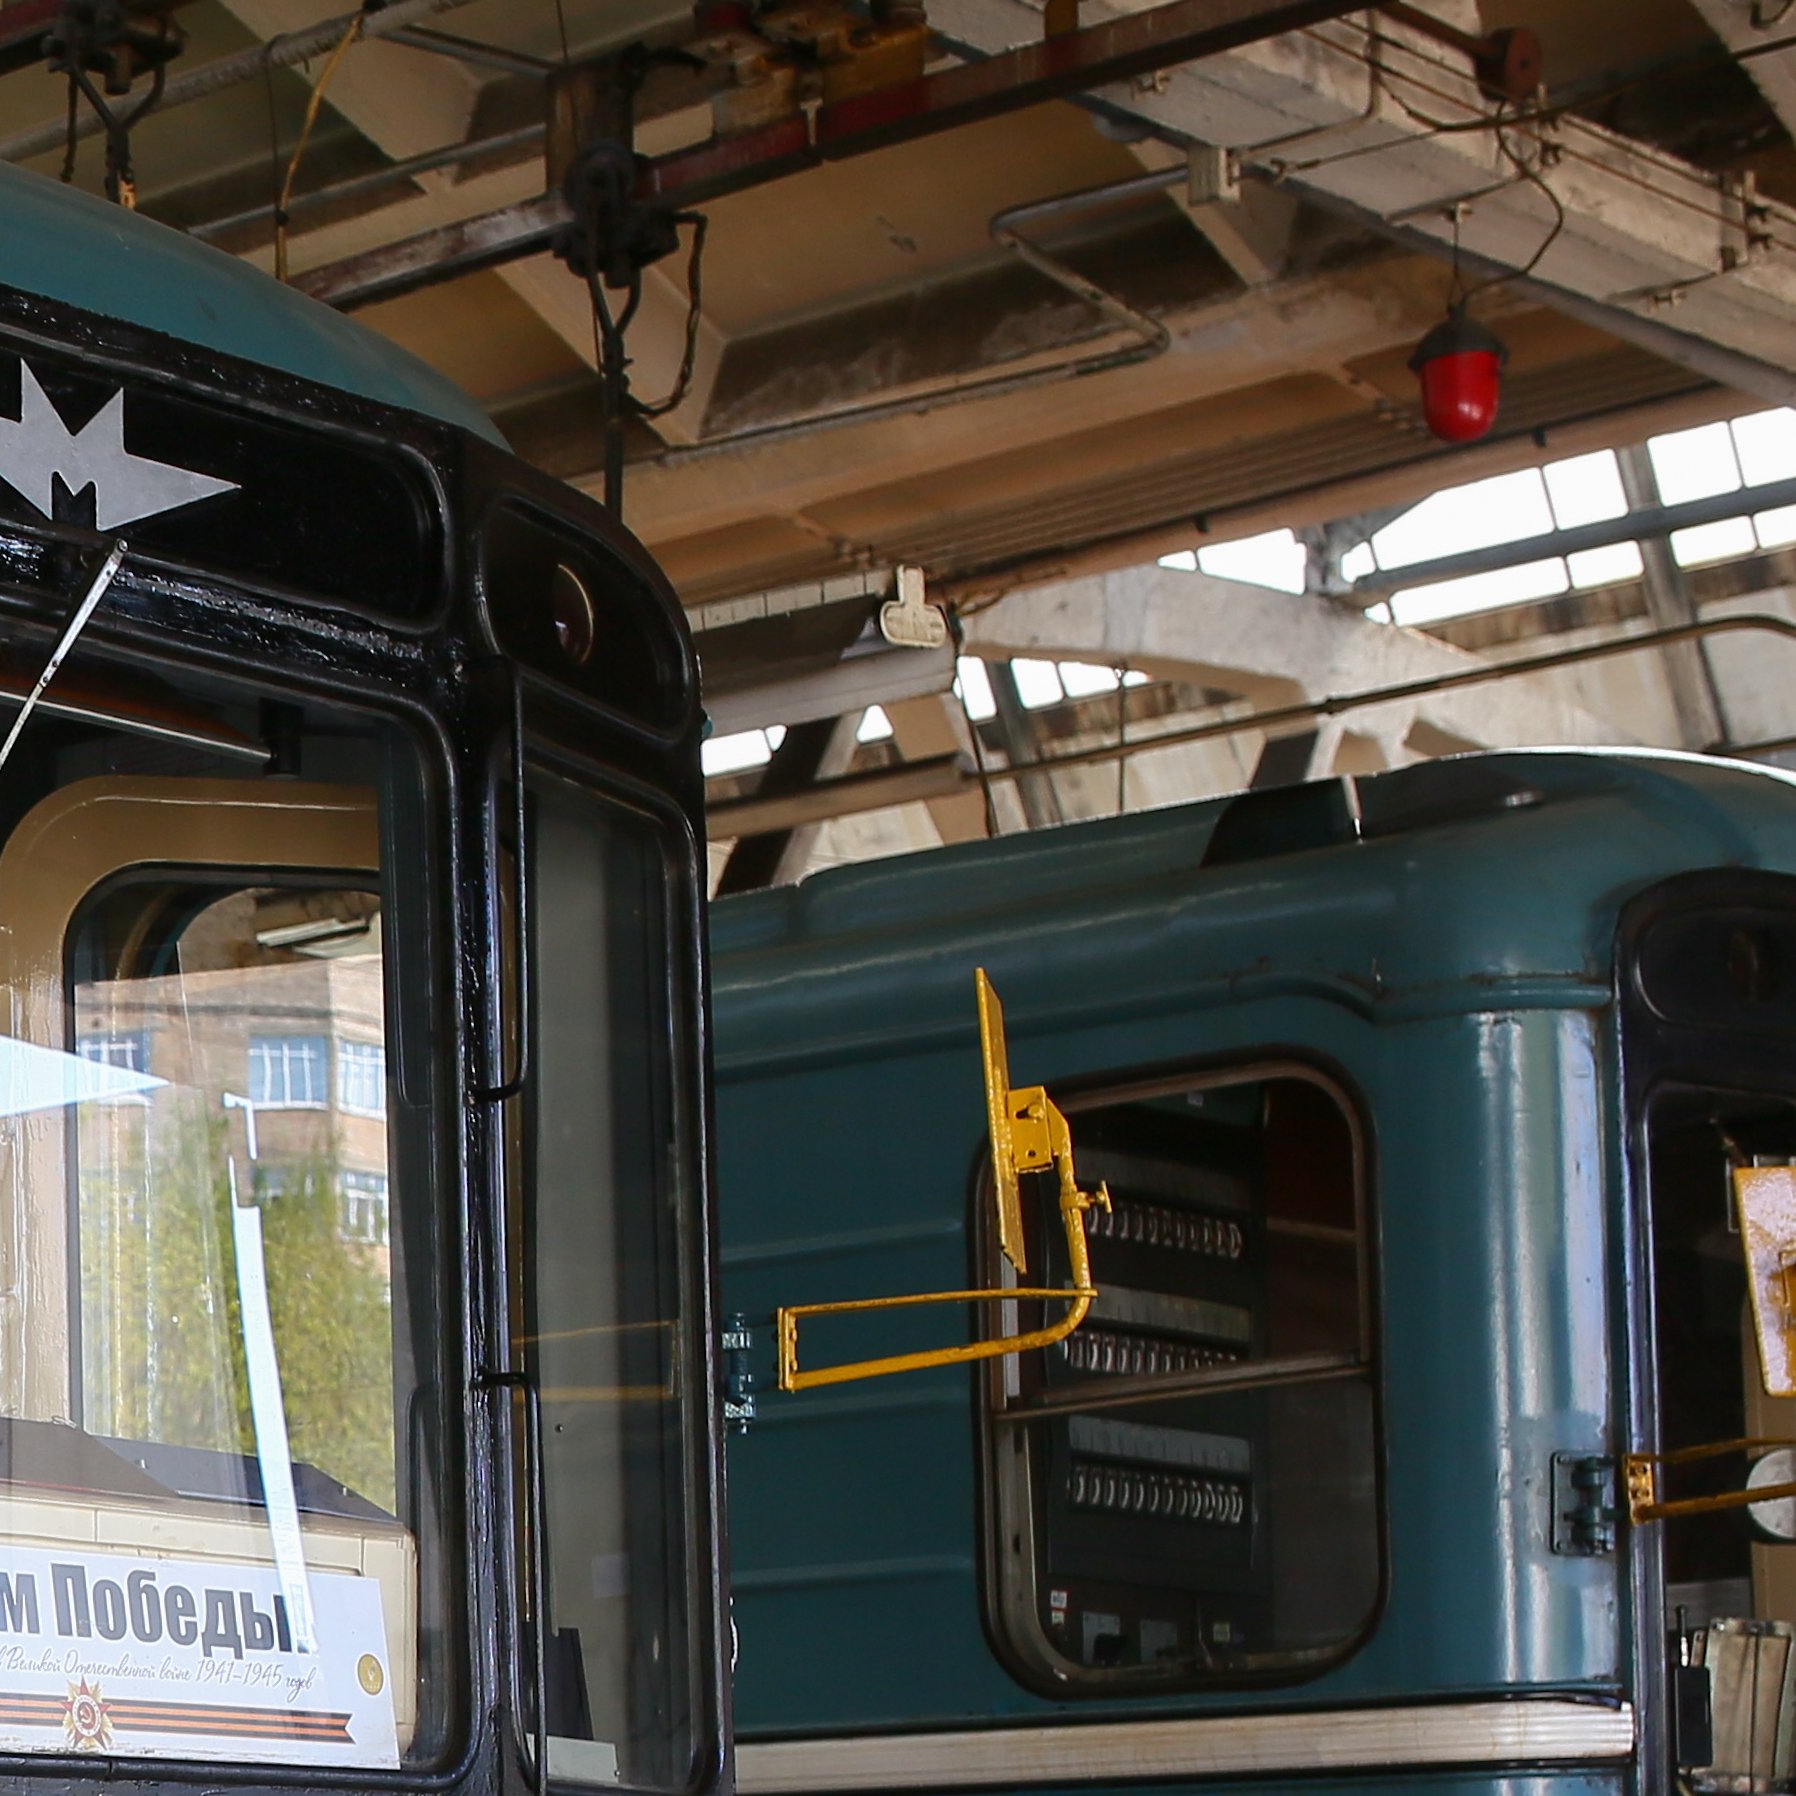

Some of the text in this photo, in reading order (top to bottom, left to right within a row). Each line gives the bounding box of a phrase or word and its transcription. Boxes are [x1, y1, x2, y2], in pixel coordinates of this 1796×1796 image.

[7, 1646, 61, 1673] Великой
[64, 1649, 155, 1679] Отечественной
[159, 1655, 192, 1681] войне
